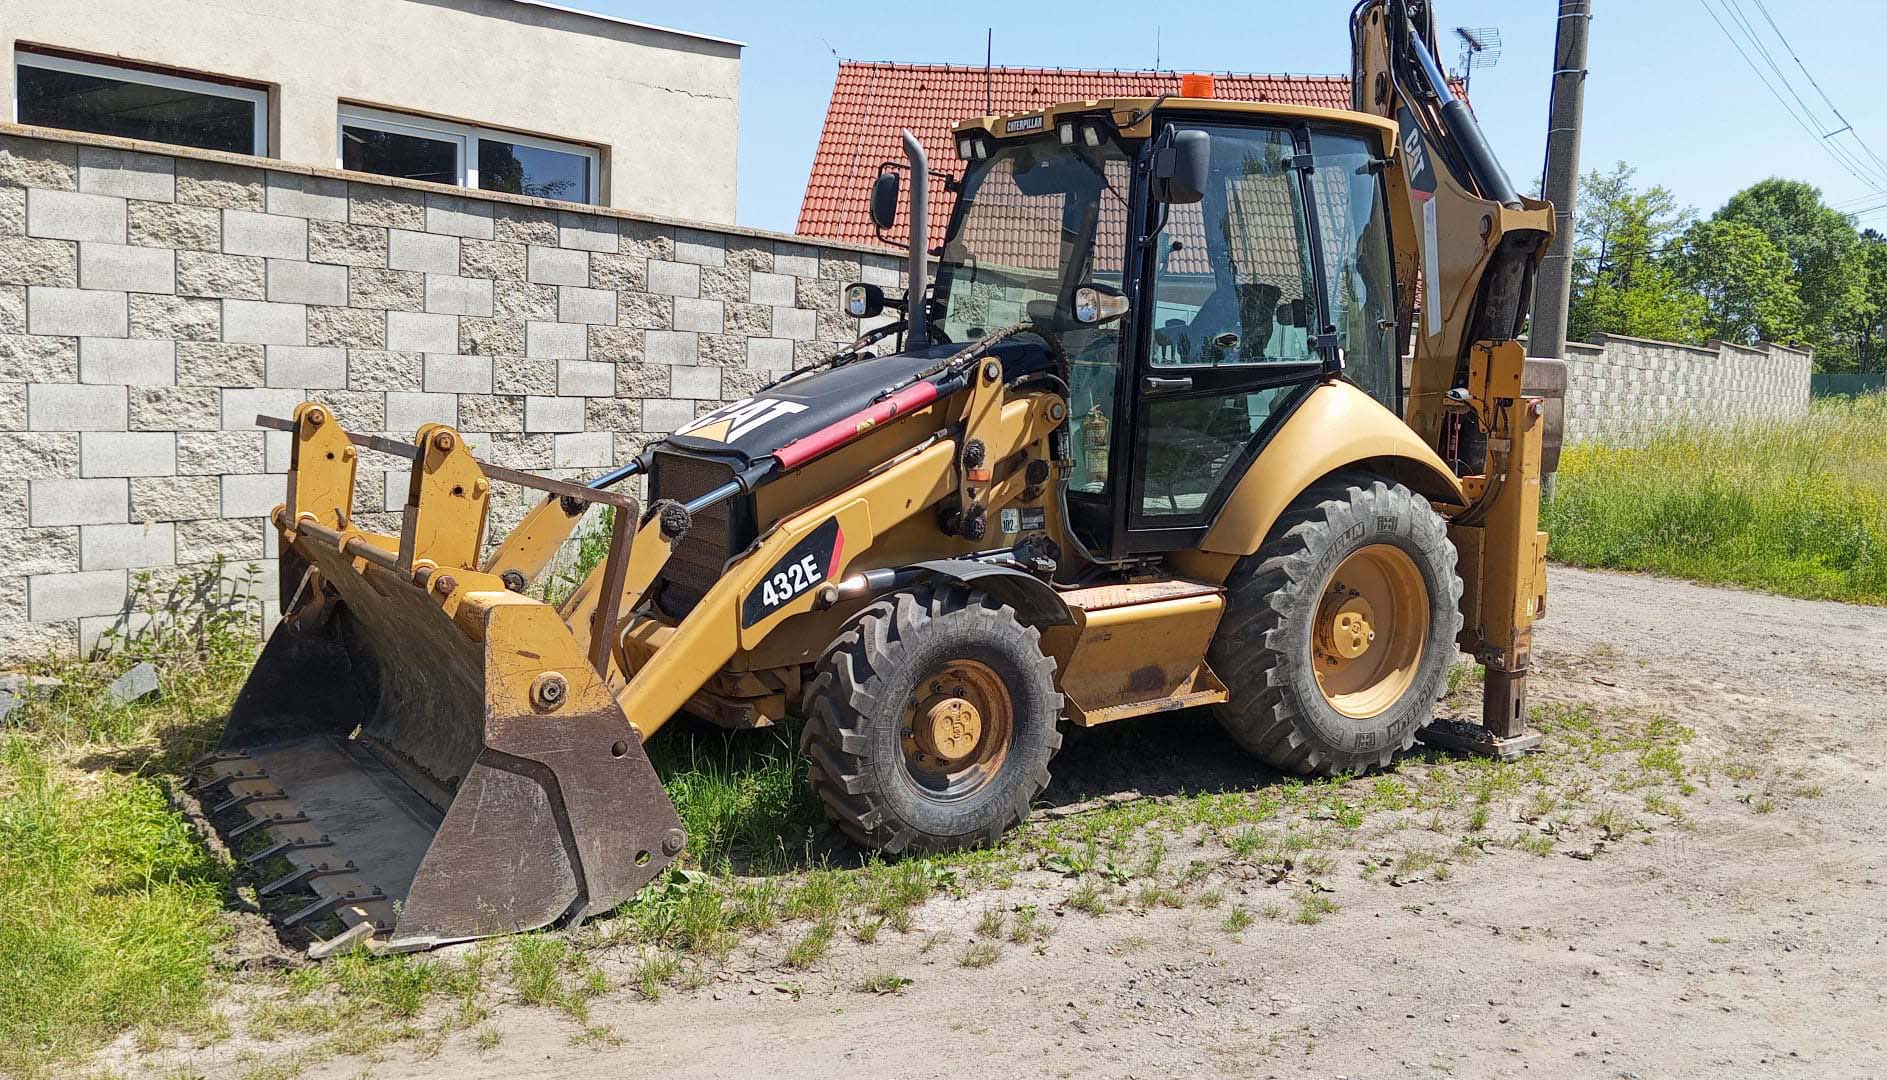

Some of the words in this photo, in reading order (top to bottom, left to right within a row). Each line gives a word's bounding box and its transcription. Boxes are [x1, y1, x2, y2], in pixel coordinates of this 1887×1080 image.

[1007, 117, 1043, 132] CATERPILLAR
[1404, 127, 1425, 182] CAT
[675, 398, 810, 445] CAT
[762, 554, 822, 606] 432E
[1309, 520, 1366, 588] MICHELIN
